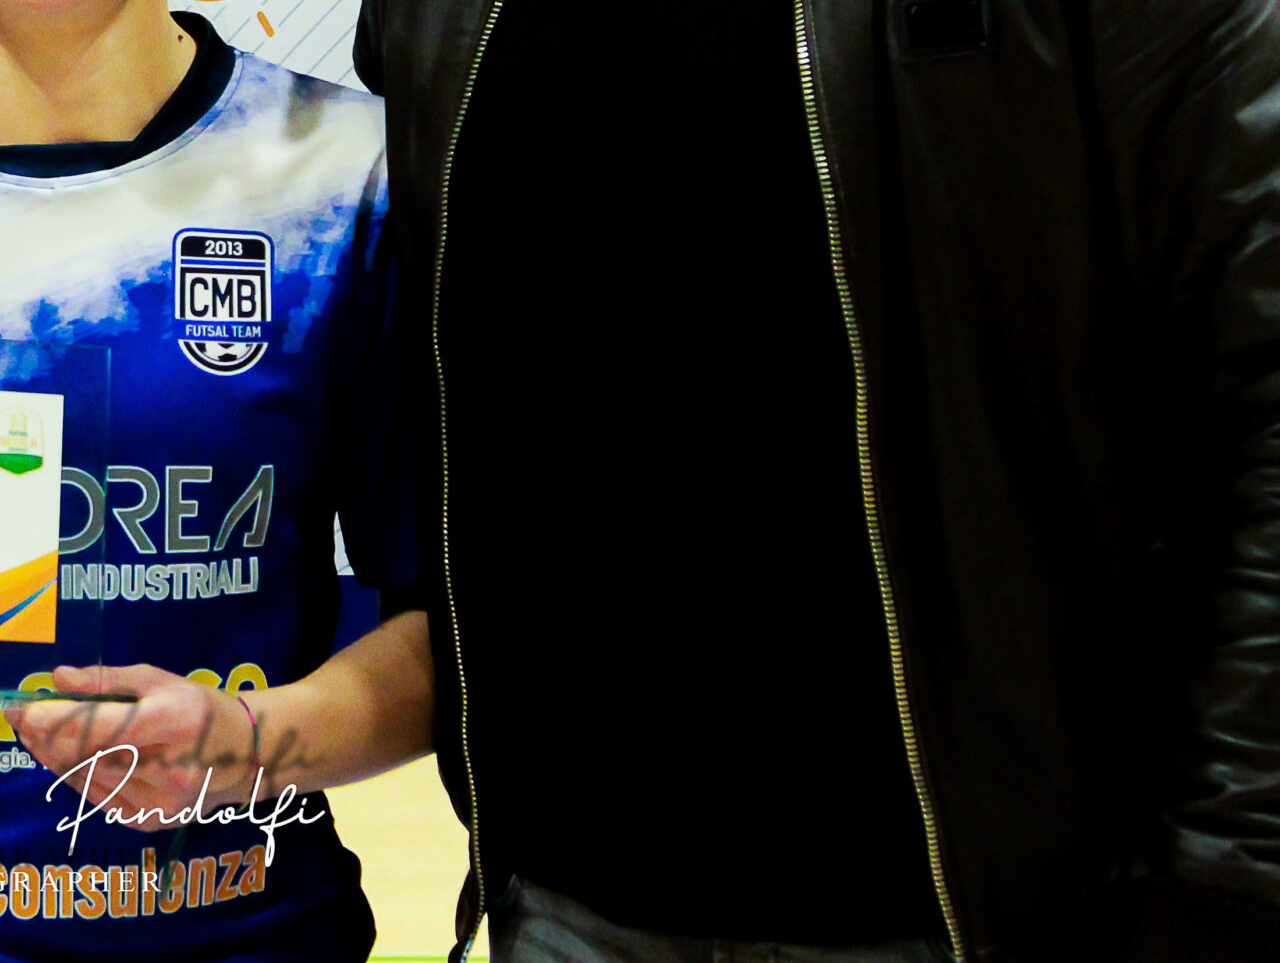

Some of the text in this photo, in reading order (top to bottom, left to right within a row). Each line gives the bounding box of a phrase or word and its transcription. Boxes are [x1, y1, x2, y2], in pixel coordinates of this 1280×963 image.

[204, 239, 244, 257] 2013
[189, 276, 258, 319] CMB
[185, 324, 262, 339] FUTSAL TEAM
[61, 557, 259, 601] INDUSTRIALI
